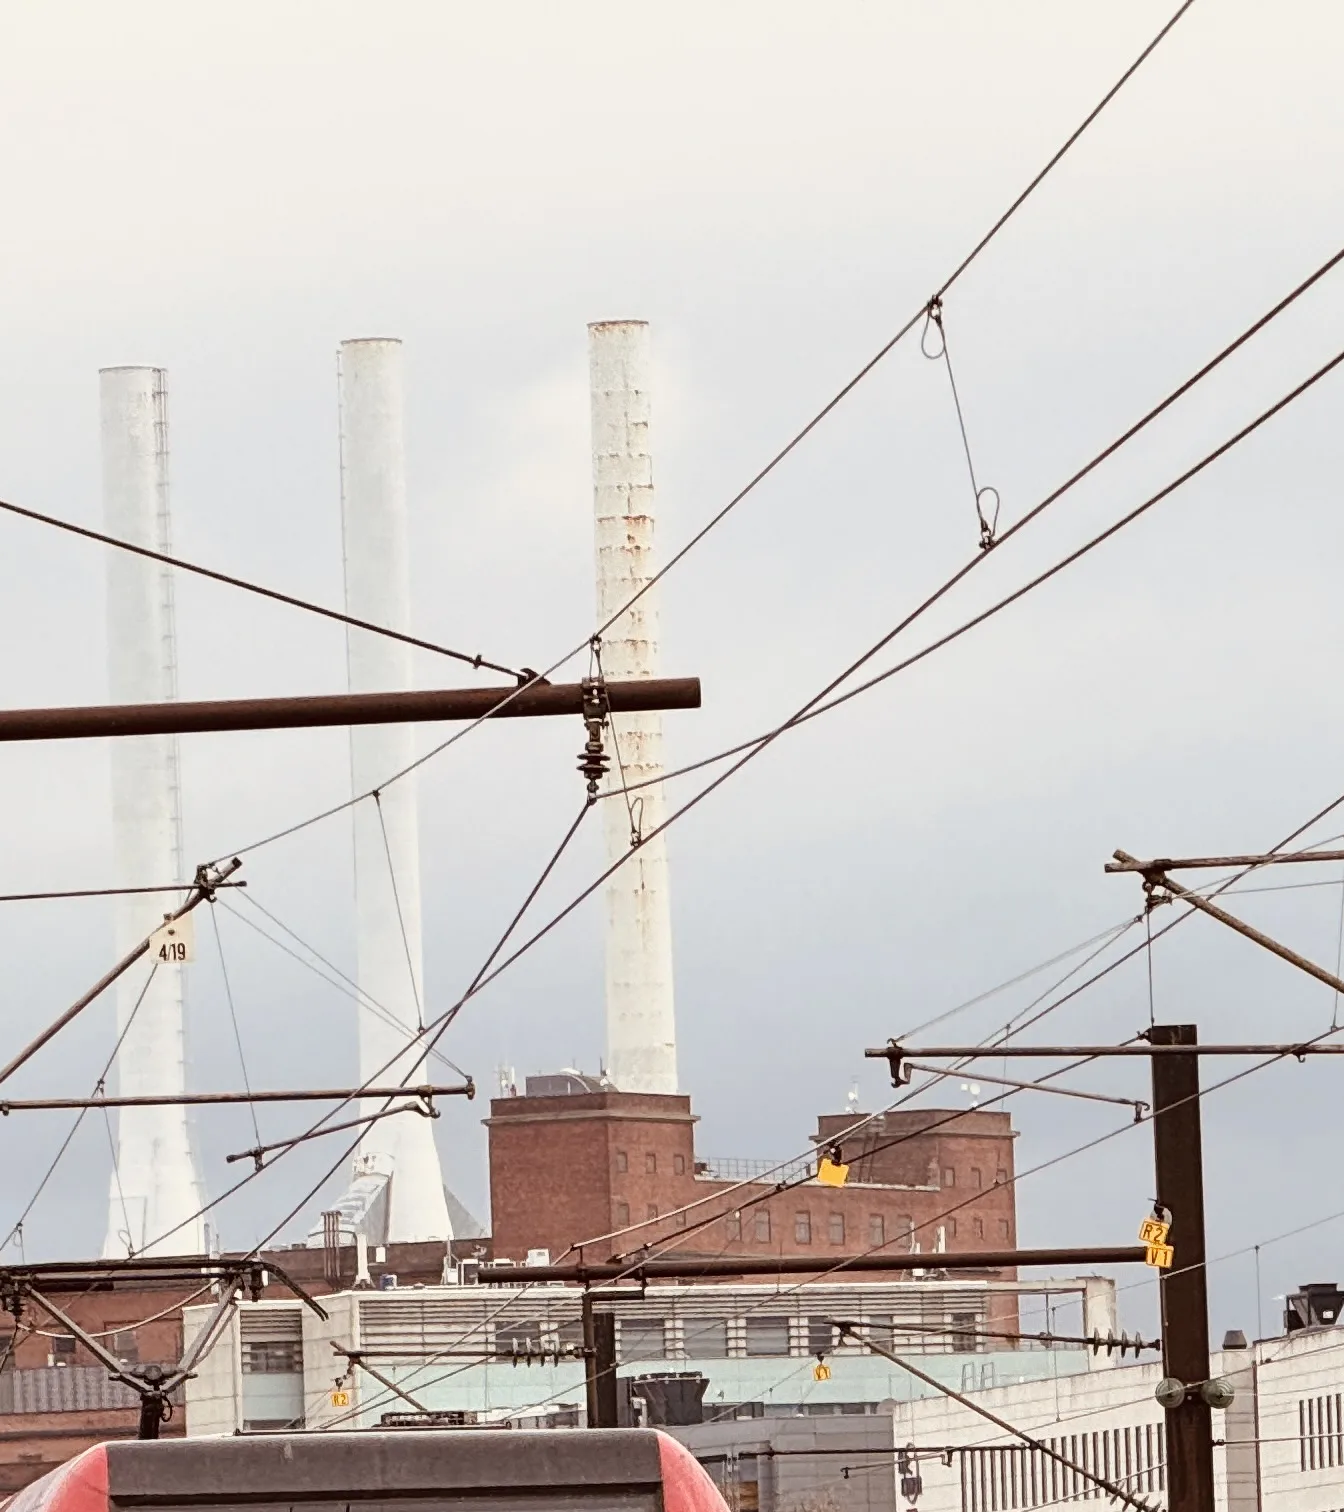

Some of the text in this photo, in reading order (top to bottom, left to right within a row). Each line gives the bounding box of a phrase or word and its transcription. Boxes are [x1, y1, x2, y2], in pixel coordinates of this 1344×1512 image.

[159, 943, 186, 961] 4/19
[1143, 1223, 1164, 1242] R2
[1151, 1248, 1168, 1266] V1
